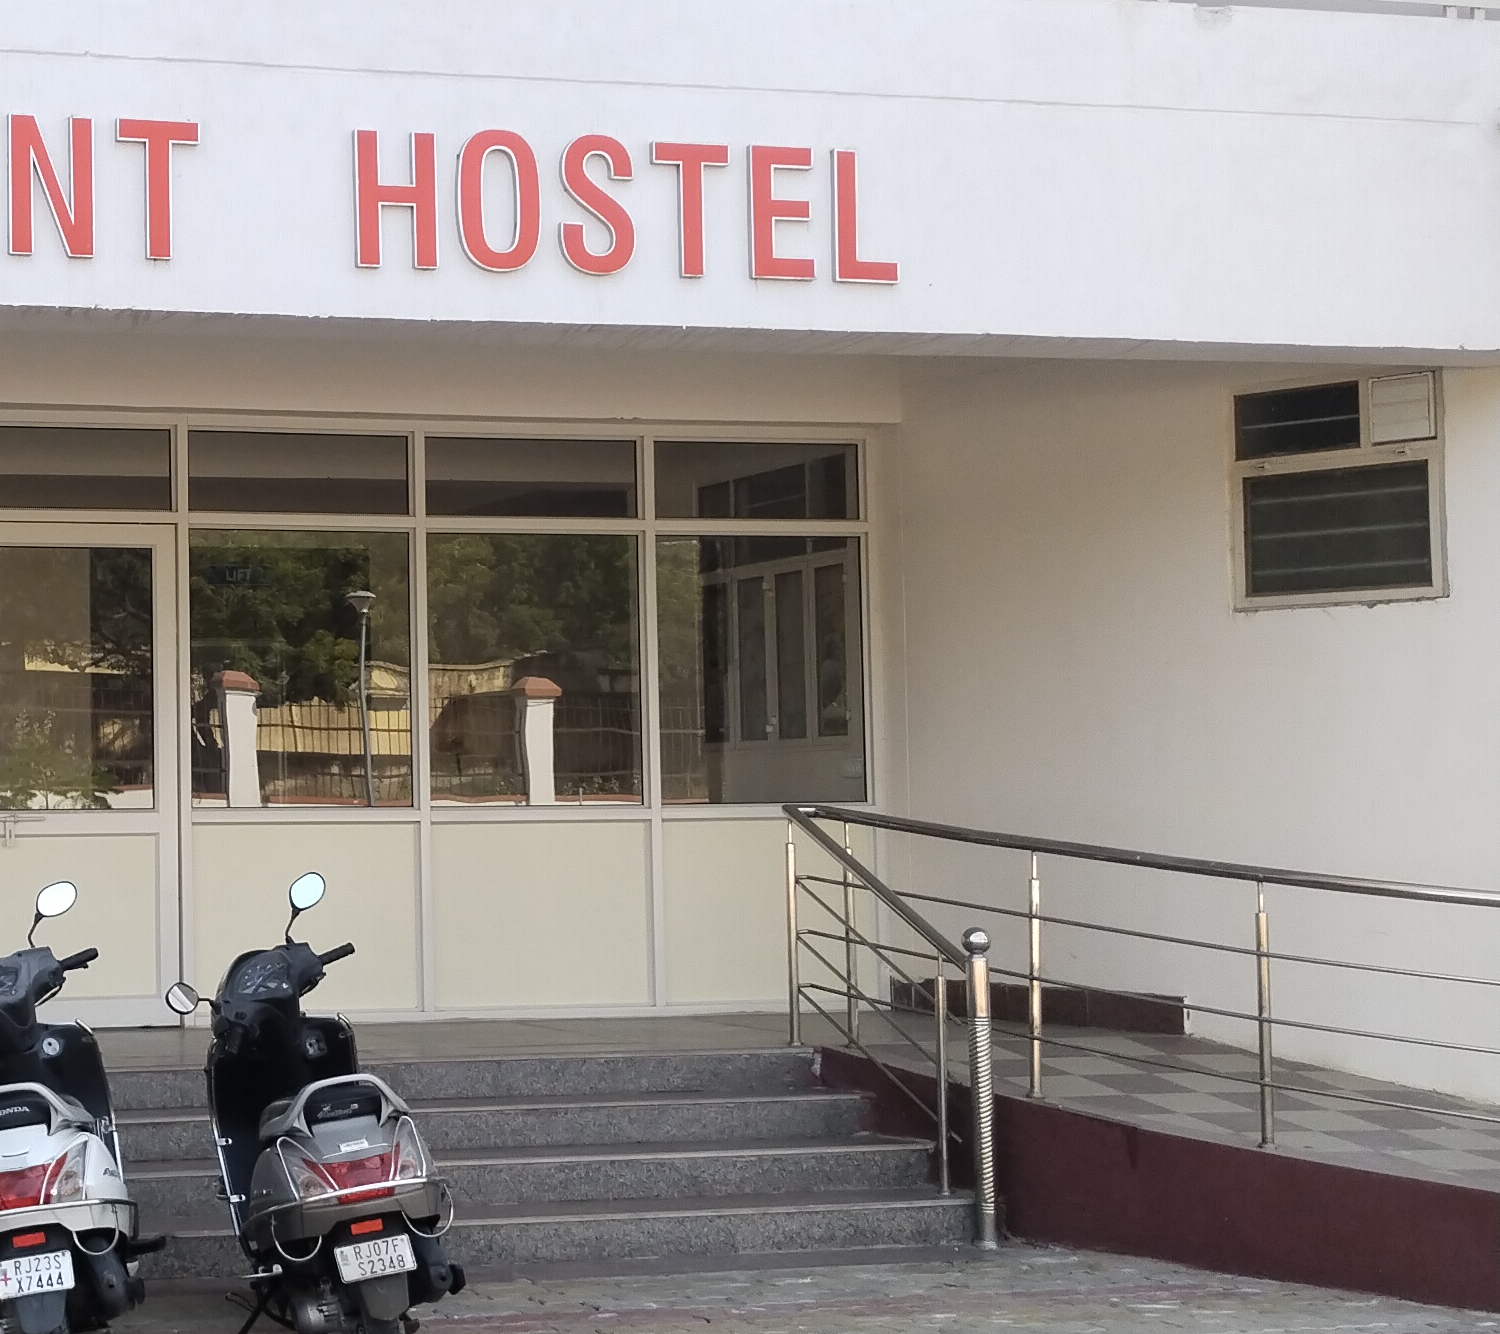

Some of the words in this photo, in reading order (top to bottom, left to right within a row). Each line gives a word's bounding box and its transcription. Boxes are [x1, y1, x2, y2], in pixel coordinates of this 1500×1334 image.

[352, 127, 901, 285] HOSTEL
[226, 568, 251, 582] LIFT
[353, 1238, 400, 1261] RJ07F
[13, 1254, 62, 1276] RJ23S
[358, 1254, 406, 1277] S2348
[16, 1271, 64, 1293] X7444
